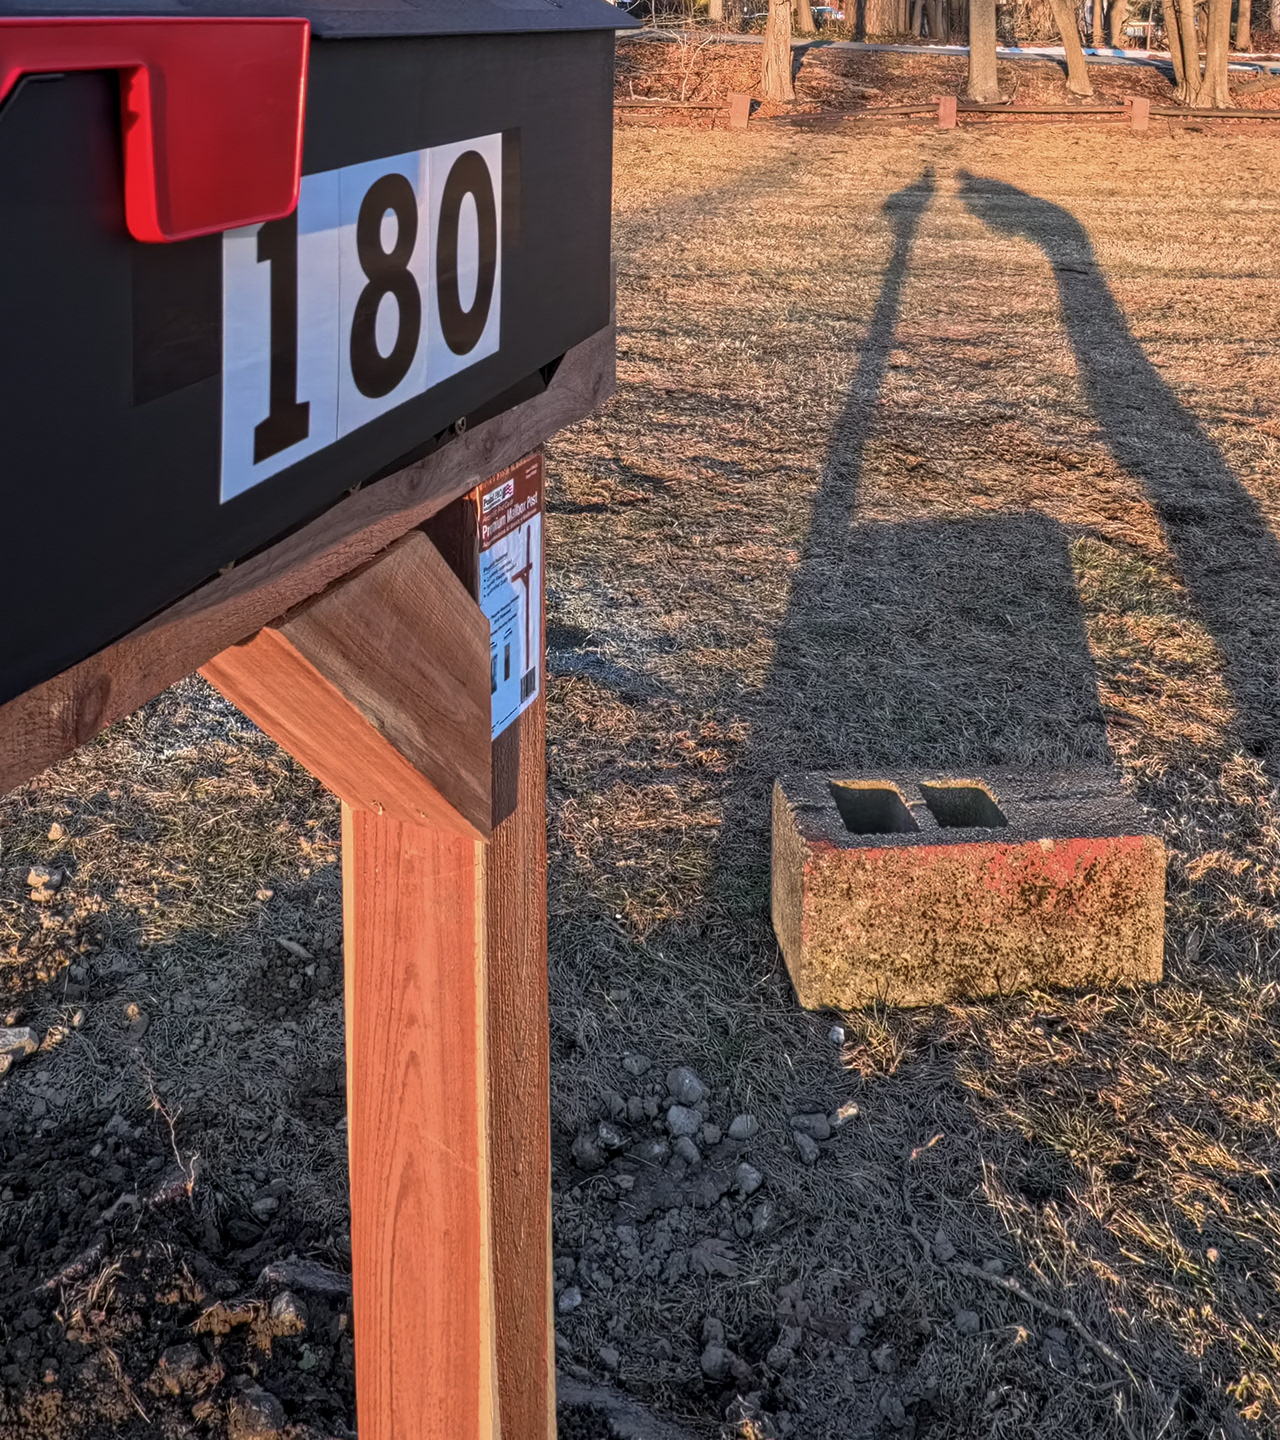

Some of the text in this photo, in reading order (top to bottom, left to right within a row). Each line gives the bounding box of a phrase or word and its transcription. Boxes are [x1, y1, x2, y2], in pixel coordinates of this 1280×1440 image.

[253, 150, 497, 465] 180
[482, 514, 507, 539] Premium
[507, 500, 527, 523] Mailbox
[527, 491, 538, 509] Post
